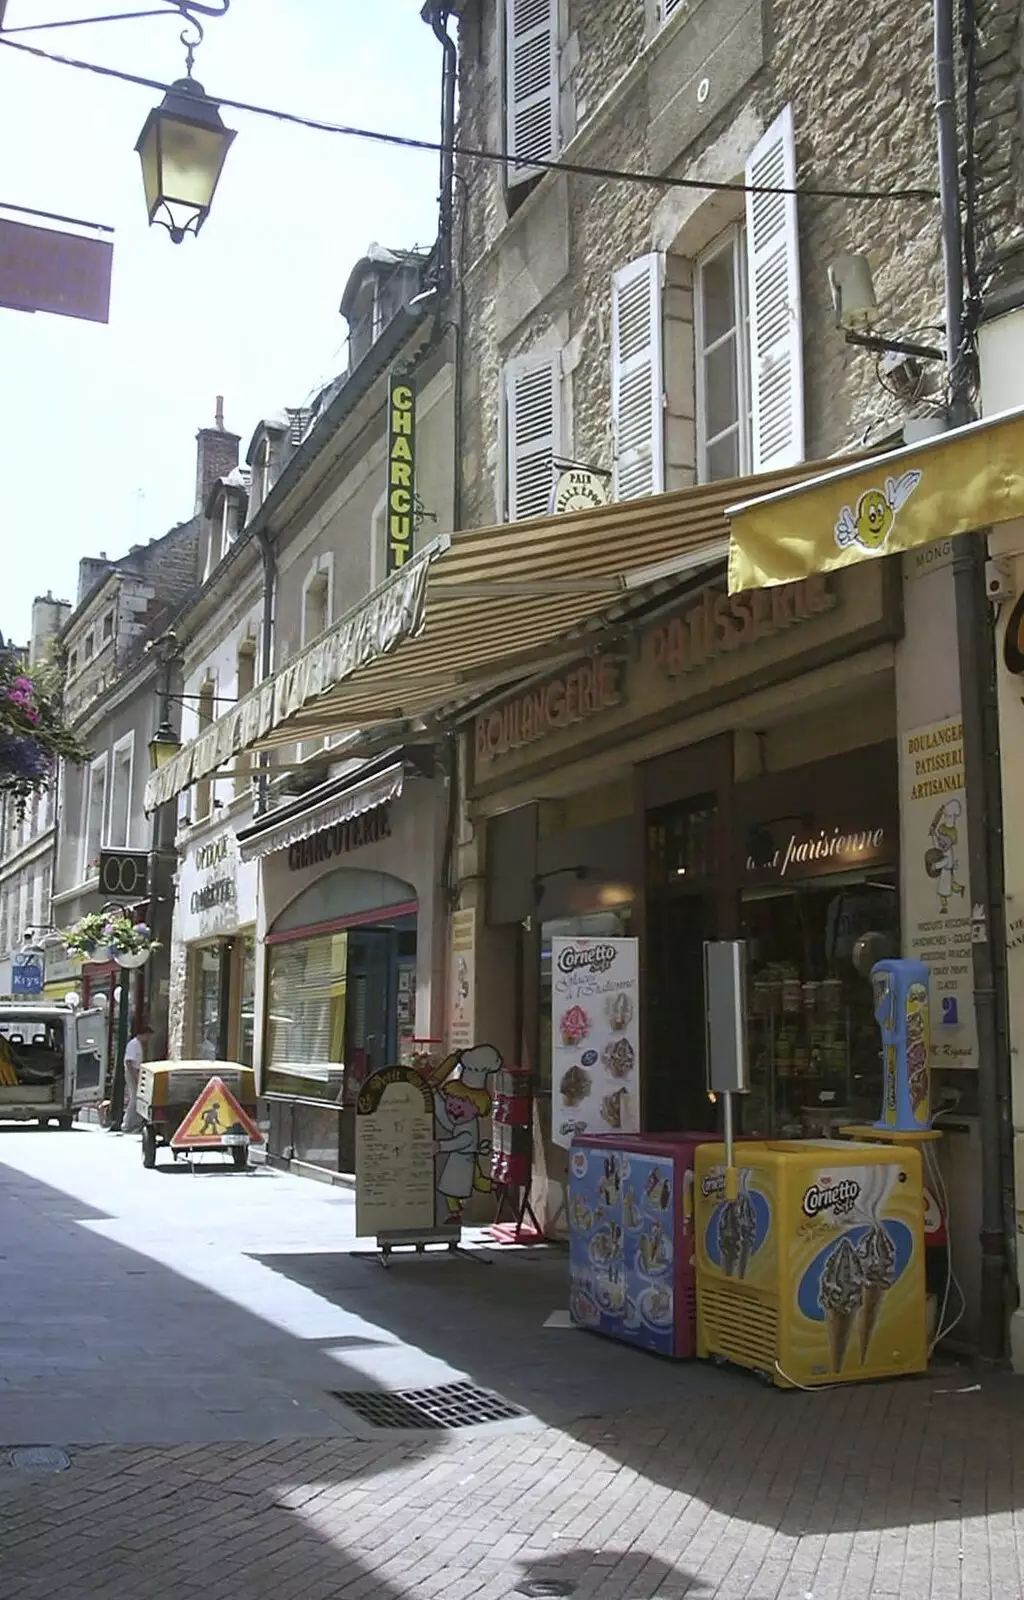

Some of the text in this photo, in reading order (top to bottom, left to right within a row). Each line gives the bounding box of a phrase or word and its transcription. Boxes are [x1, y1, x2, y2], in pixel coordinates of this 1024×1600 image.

[390, 386, 413, 569] CHARCUT
[570, 473, 592, 485] PAIN
[916, 541, 951, 567] MONG
[475, 655, 623, 760] BOULANGERIE
[908, 723, 963, 754] BOULANGER
[915, 748, 963, 776] PATISSERI
[910, 773, 964, 800] ARTISANAL
[780, 827, 884, 876] parisienne
[557, 944, 618, 974] Cornetto
[803, 1178, 860, 1217] Cornetto
